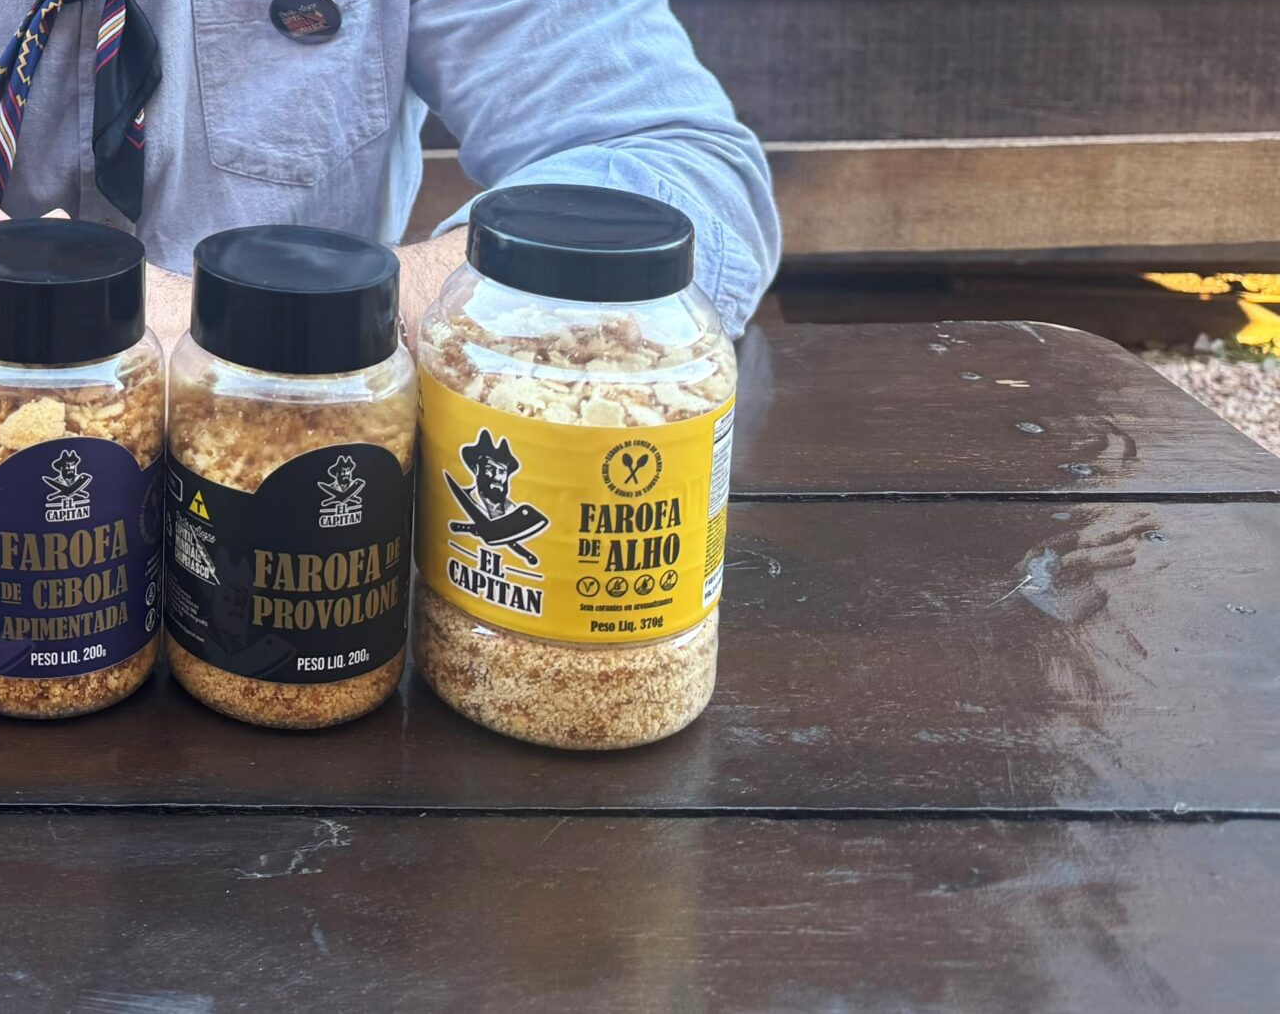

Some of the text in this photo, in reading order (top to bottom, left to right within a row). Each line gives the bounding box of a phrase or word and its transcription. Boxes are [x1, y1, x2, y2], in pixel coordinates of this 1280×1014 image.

[46, 506, 89, 522] CAPITAN
[62, 498, 74, 510] EL
[320, 511, 362, 527] CAPITAN
[336, 503, 348, 514] EL
[579, 498, 681, 533] FAROFA
[0, 520, 128, 572] FAROFA
[578, 533, 680, 572] DE ALHO
[254, 536, 400, 592] FAROFA DE
[480, 548, 504, 578] EL
[1, 564, 128, 610] DE CEBOLA
[253, 576, 399, 630] PROVOLONE
[448, 559, 542, 615] CAPITAN
[2, 600, 128, 642] APIMENTADA
[590, 616, 664, 632] Peso Liq. 370g
[31, 644, 106, 666] PESO LIQ. 200g
[297, 649, 370, 671] PESO LIQ. 200g
